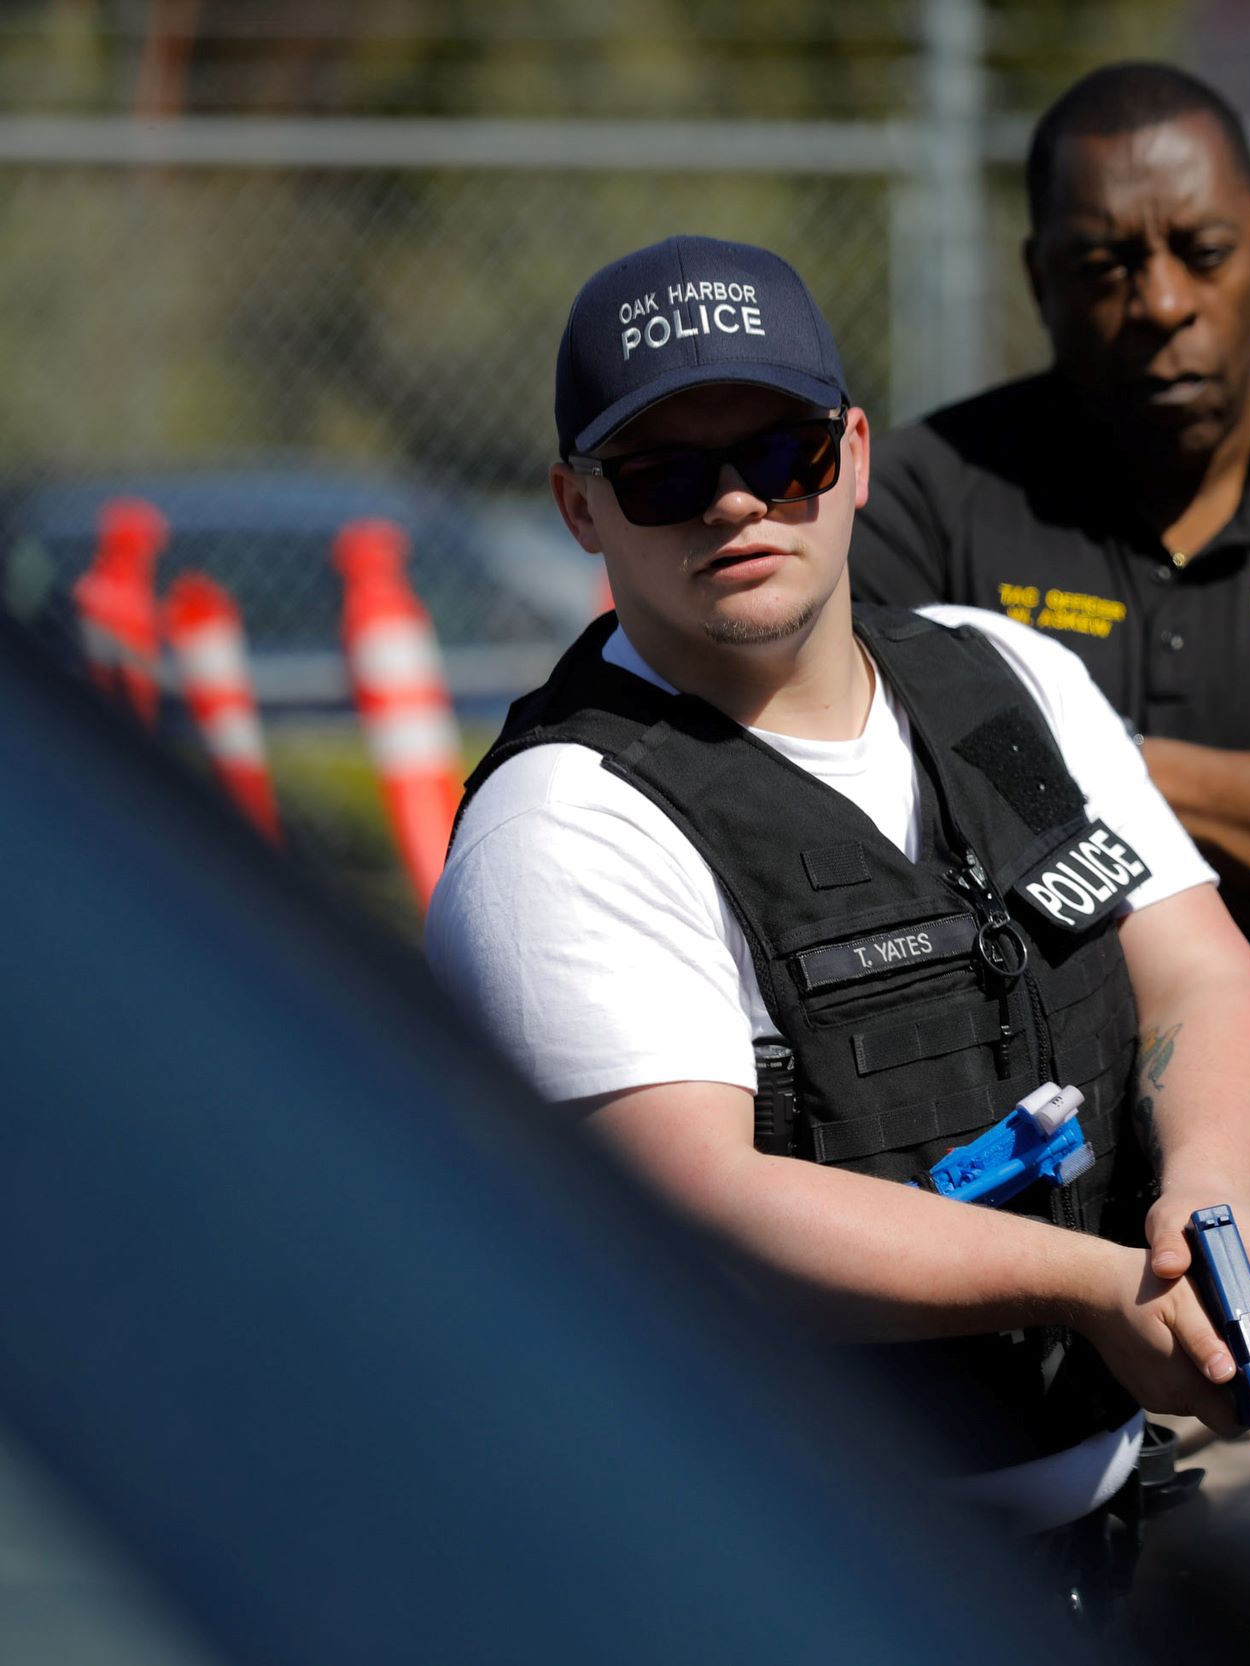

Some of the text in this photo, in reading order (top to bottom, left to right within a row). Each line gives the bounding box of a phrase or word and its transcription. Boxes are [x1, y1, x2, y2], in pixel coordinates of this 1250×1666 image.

[618, 281, 758, 325] OAK HARBOR
[621, 303, 766, 361] POLICE
[1045, 588, 1126, 623] OFFICER
[1025, 828, 1146, 926] POLICE
[853, 931, 934, 969] T. YATES
